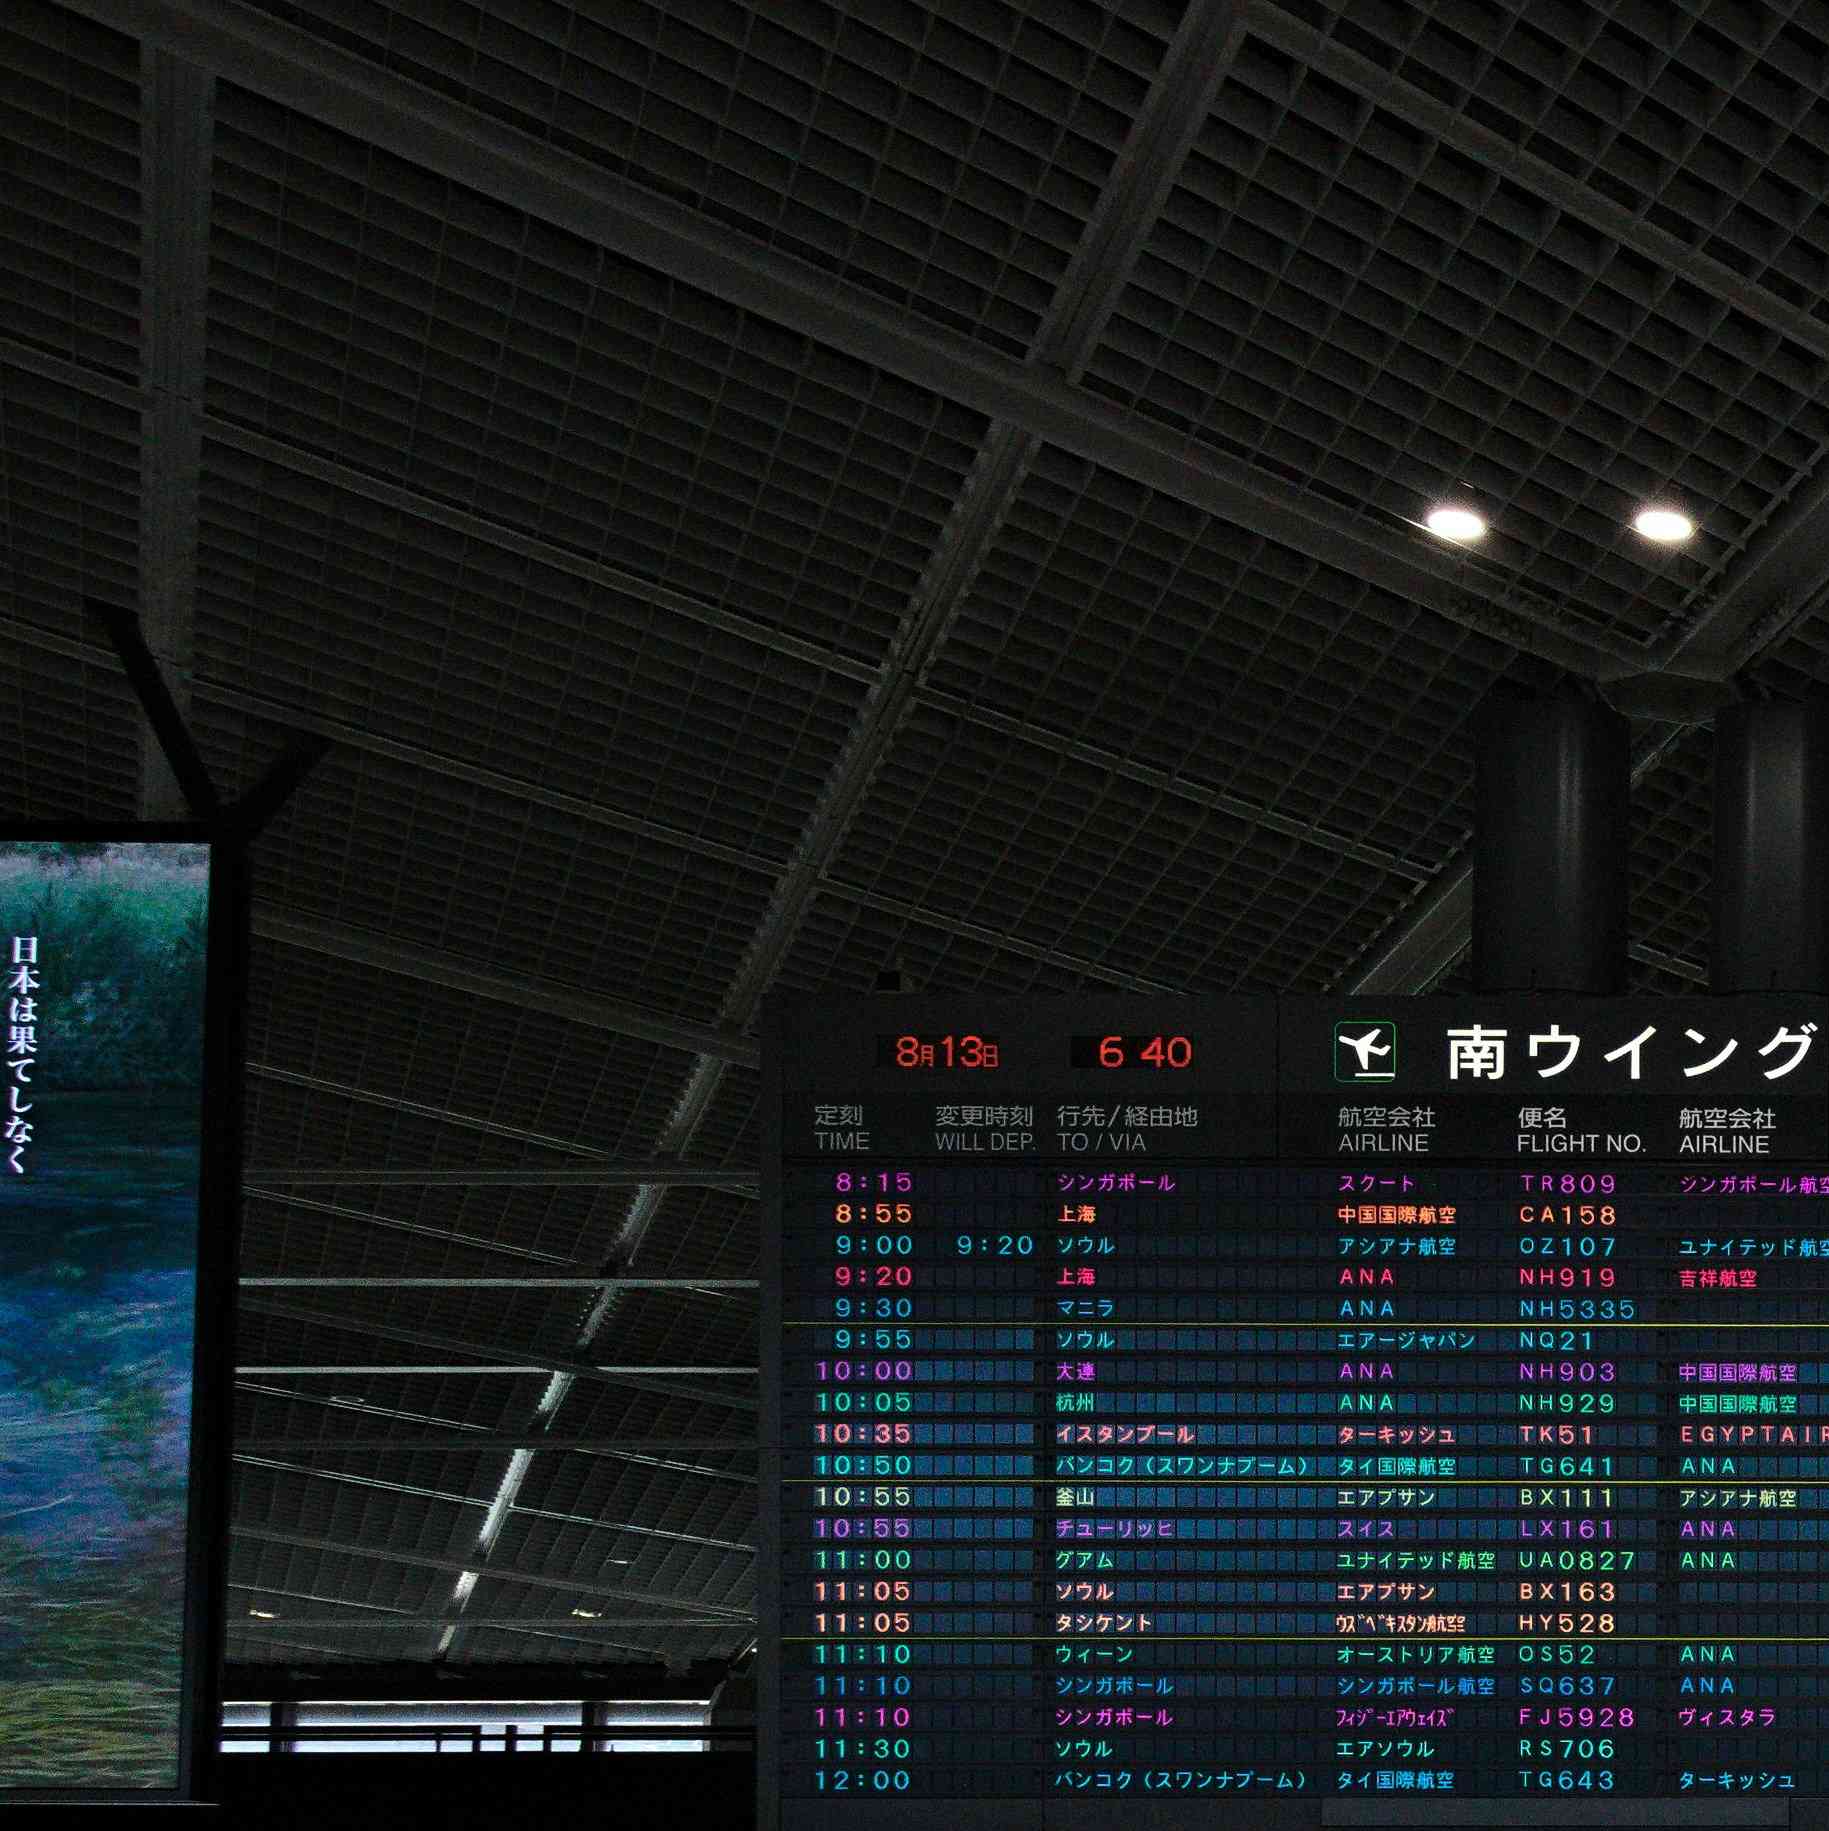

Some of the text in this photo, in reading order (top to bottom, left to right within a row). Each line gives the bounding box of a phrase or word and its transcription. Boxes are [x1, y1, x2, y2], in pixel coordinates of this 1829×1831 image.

[5, 934, 40, 1176] 日本は果てしなく
[896, 1035, 999, 1068] 8月13日
[1099, 1036, 1192, 1068] 6 40
[814, 1103, 863, 1127] 定刻
[935, 1104, 1034, 1128] 変更時刻
[1338, 1105, 1437, 1129] 航空会社
[1517, 1106, 1567, 1129] 便名
[813, 1131, 870, 1151] TIME
[934, 1131, 1034, 1152] WILL DEP.
[1056, 1132, 1147, 1152] TO VIA
[1338, 1133, 1429, 1153] AIRLINE
[1517, 1133, 1647, 1153] FLIGHT NO.
[836, 1172, 912, 1192] 8:15
[1339, 1174, 1414, 1193] スクート
[1521, 1174, 1615, 1195] TR809
[836, 1235, 913, 1255] 9:00
[957, 1235, 1034, 1256] 9:20
[1058, 1235, 1116, 1255] ソウル
[1340, 1236, 1456, 1256] アシアナ航空
[1519, 1236, 1615, 1257] OZ107
[835, 1265, 912, 1287] 9:20
[1057, 1267, 1096, 1287] 上海
[1339, 1268, 1394, 1285] ANA
[1519, 1267, 1615, 1288] NH919
[1680, 1268, 1757, 1288] 吉祥航空
[816, 1423, 911, 1444] 10:35
[1339, 1425, 1456, 1445] ターキッシュ
[1519, 1424, 1591, 1445] TK51
